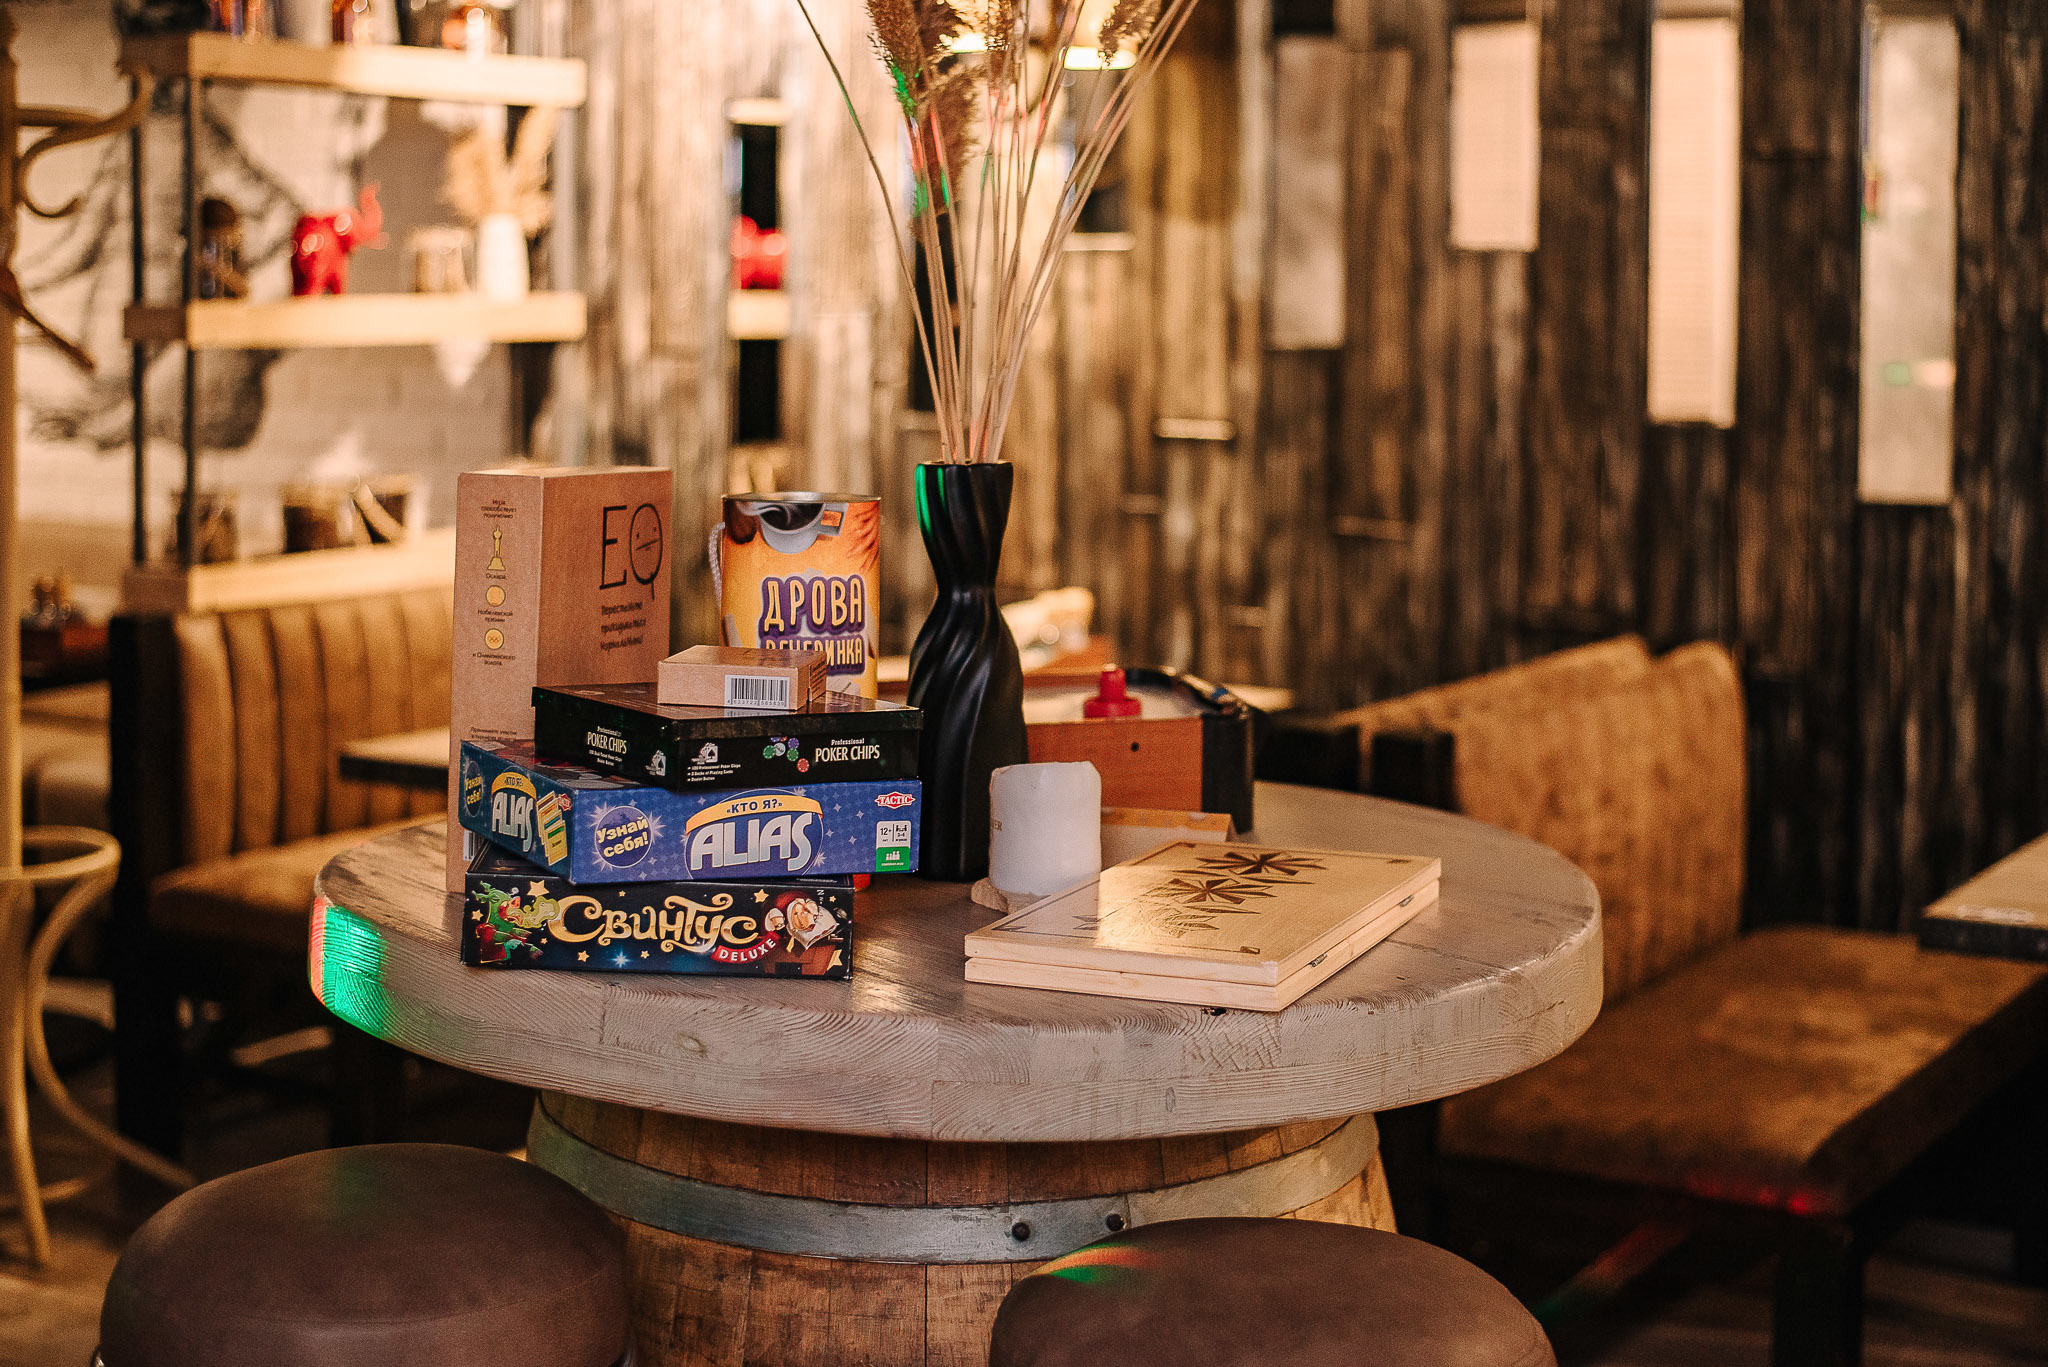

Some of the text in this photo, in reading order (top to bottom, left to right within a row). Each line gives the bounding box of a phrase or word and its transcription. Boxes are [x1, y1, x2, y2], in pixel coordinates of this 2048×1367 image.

[600, 503, 663, 600] EQ
[763, 577, 863, 633] ДРОВА
[587, 731, 627, 755] POKER CHIPS
[815, 744, 880, 763] POKER CHIPS
[831, 738, 865, 746] Professional
[726, 798, 783, 815] «КТО Я?»
[880, 795, 911, 805] TACTIC
[491, 791, 534, 852] ALIAS
[596, 816, 649, 844] Узнай
[880, 827, 892, 836] 12+
[603, 831, 650, 859] себя!
[690, 812, 813, 872] ALIAS
[719, 938, 777, 963] DELUXE
